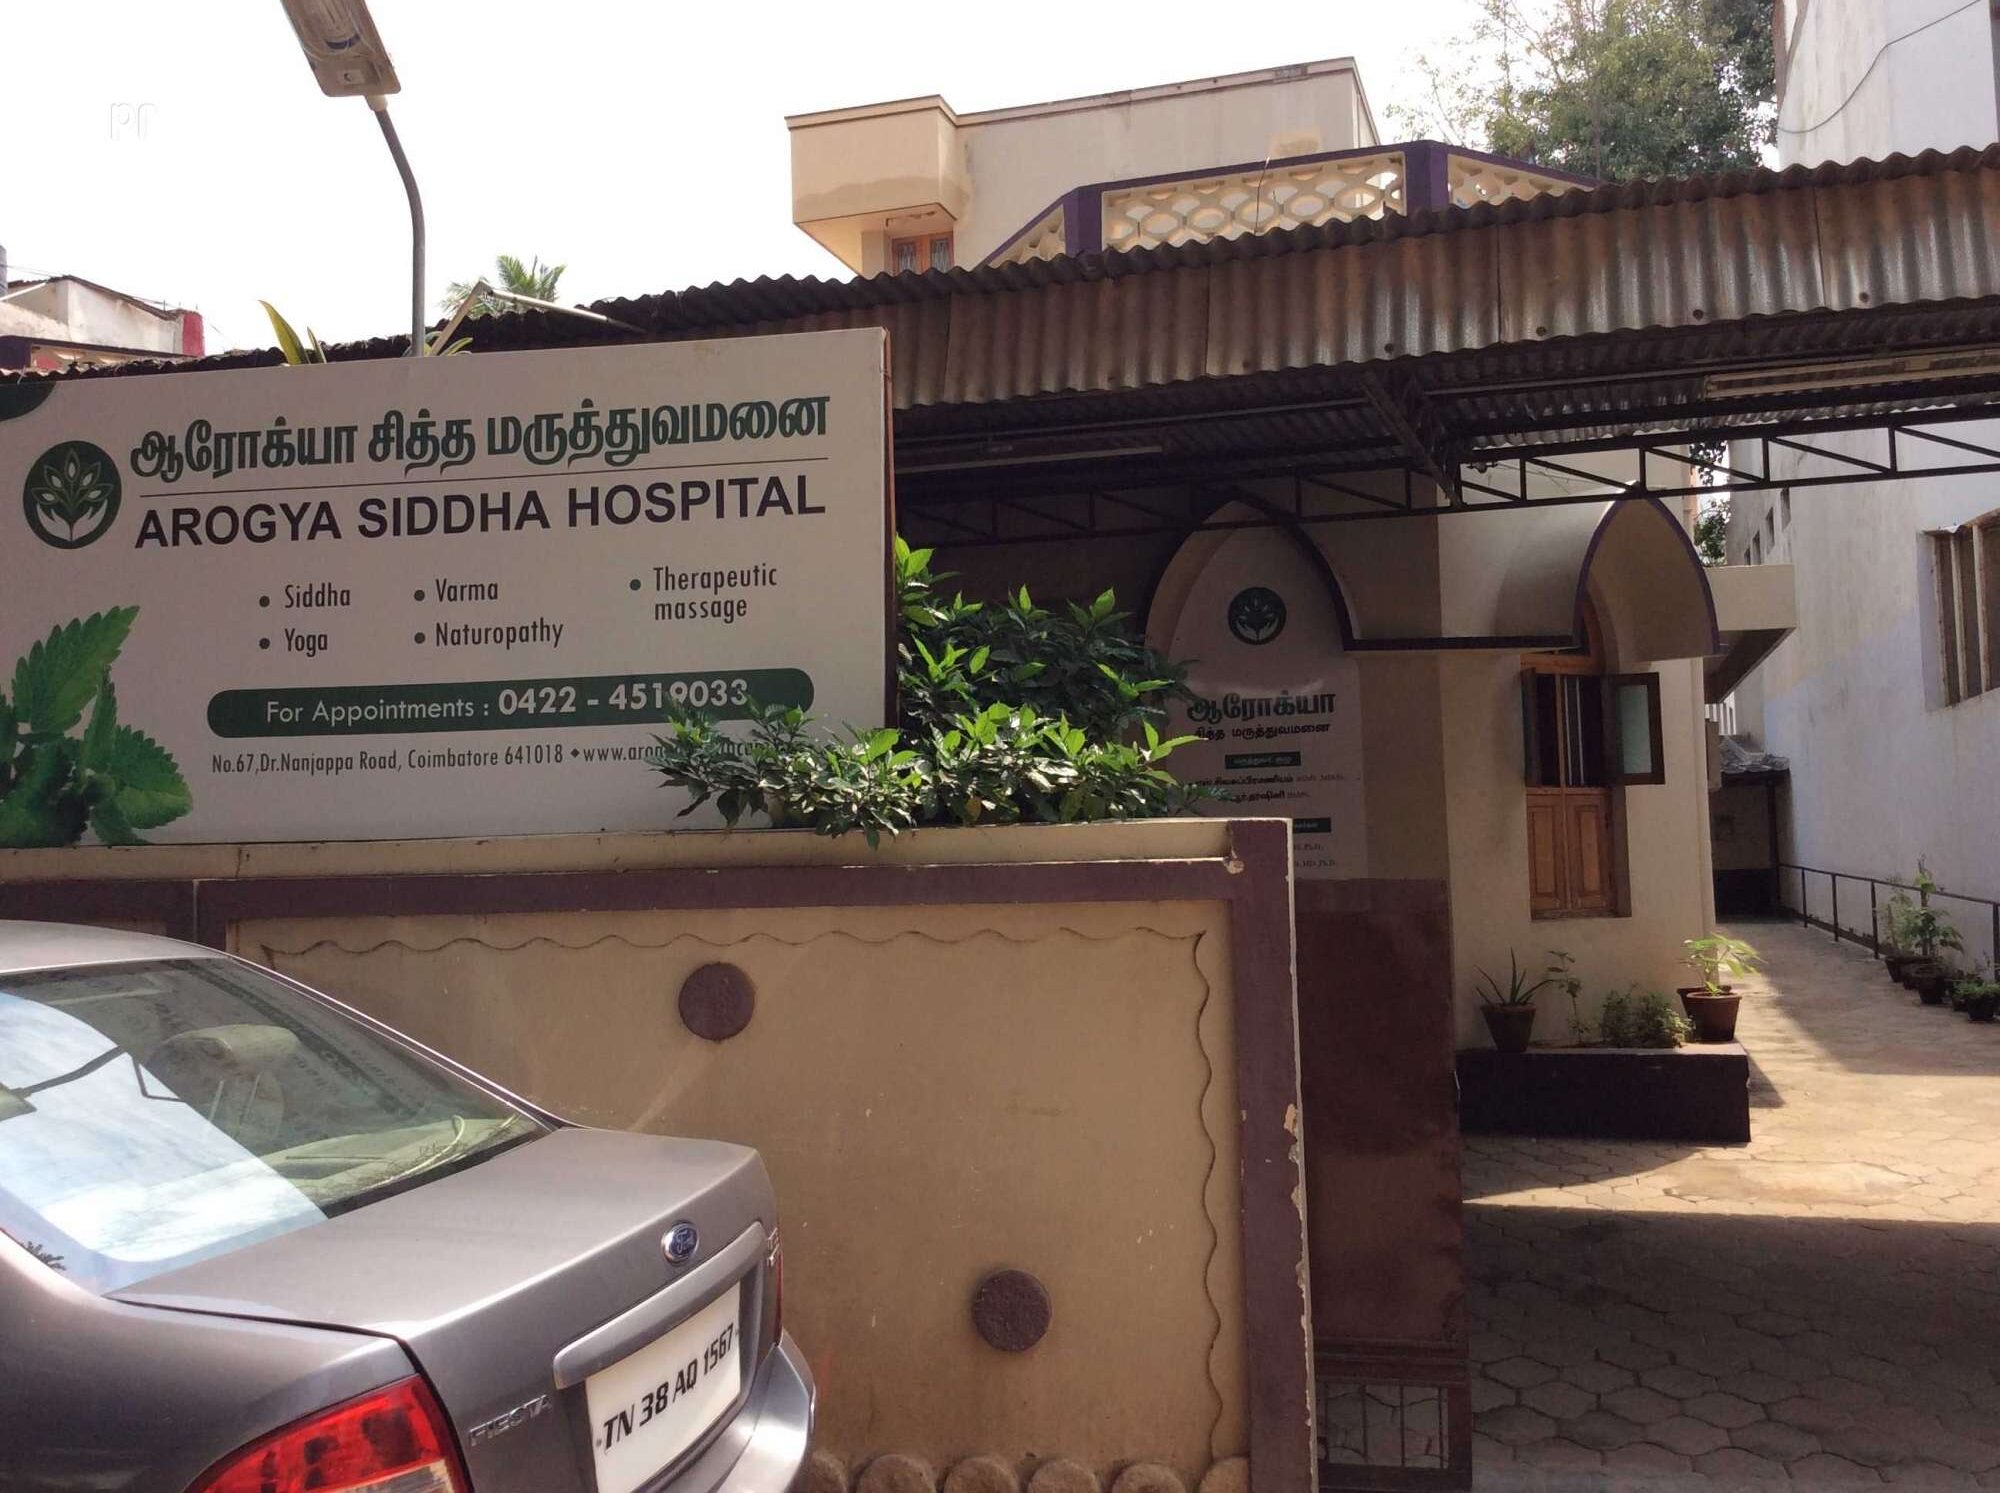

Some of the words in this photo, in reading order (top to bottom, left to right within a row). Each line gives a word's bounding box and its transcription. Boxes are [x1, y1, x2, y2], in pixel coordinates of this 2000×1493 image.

[130, 416, 358, 483] ஆரோக்யா
[367, 408, 476, 479] சித்த
[487, 396, 830, 469] மருத்துவமனை
[134, 501, 342, 549] AROGYA
[357, 490, 550, 539] SIDDHA
[567, 474, 826, 528] HOSPITAL
[284, 582, 351, 608] Siddha
[435, 578, 499, 603] Varma
[653, 563, 777, 595] Therapeutic
[654, 599, 747, 624] massage
[284, 628, 328, 657] Yoga
[435, 616, 564, 650] Naturopathy
[266, 700, 304, 723] For
[312, 698, 475, 727] Appointments
[498, 685, 577, 715] 0422
[608, 678, 748, 710] 4519033
[1187, 690, 1336, 724] ஆரோக்யா
[359, 750, 402, 773] Road,
[407, 746, 499, 770] Coimbatore
[504, 743, 564, 764] 641018
[603, 1403, 635, 1450] TN
[639, 1381, 669, 1427] 38
[672, 1358, 698, 1403] AQ
[704, 1322, 734, 1376] 1567
[468, 1394, 553, 1447] FIESTA
